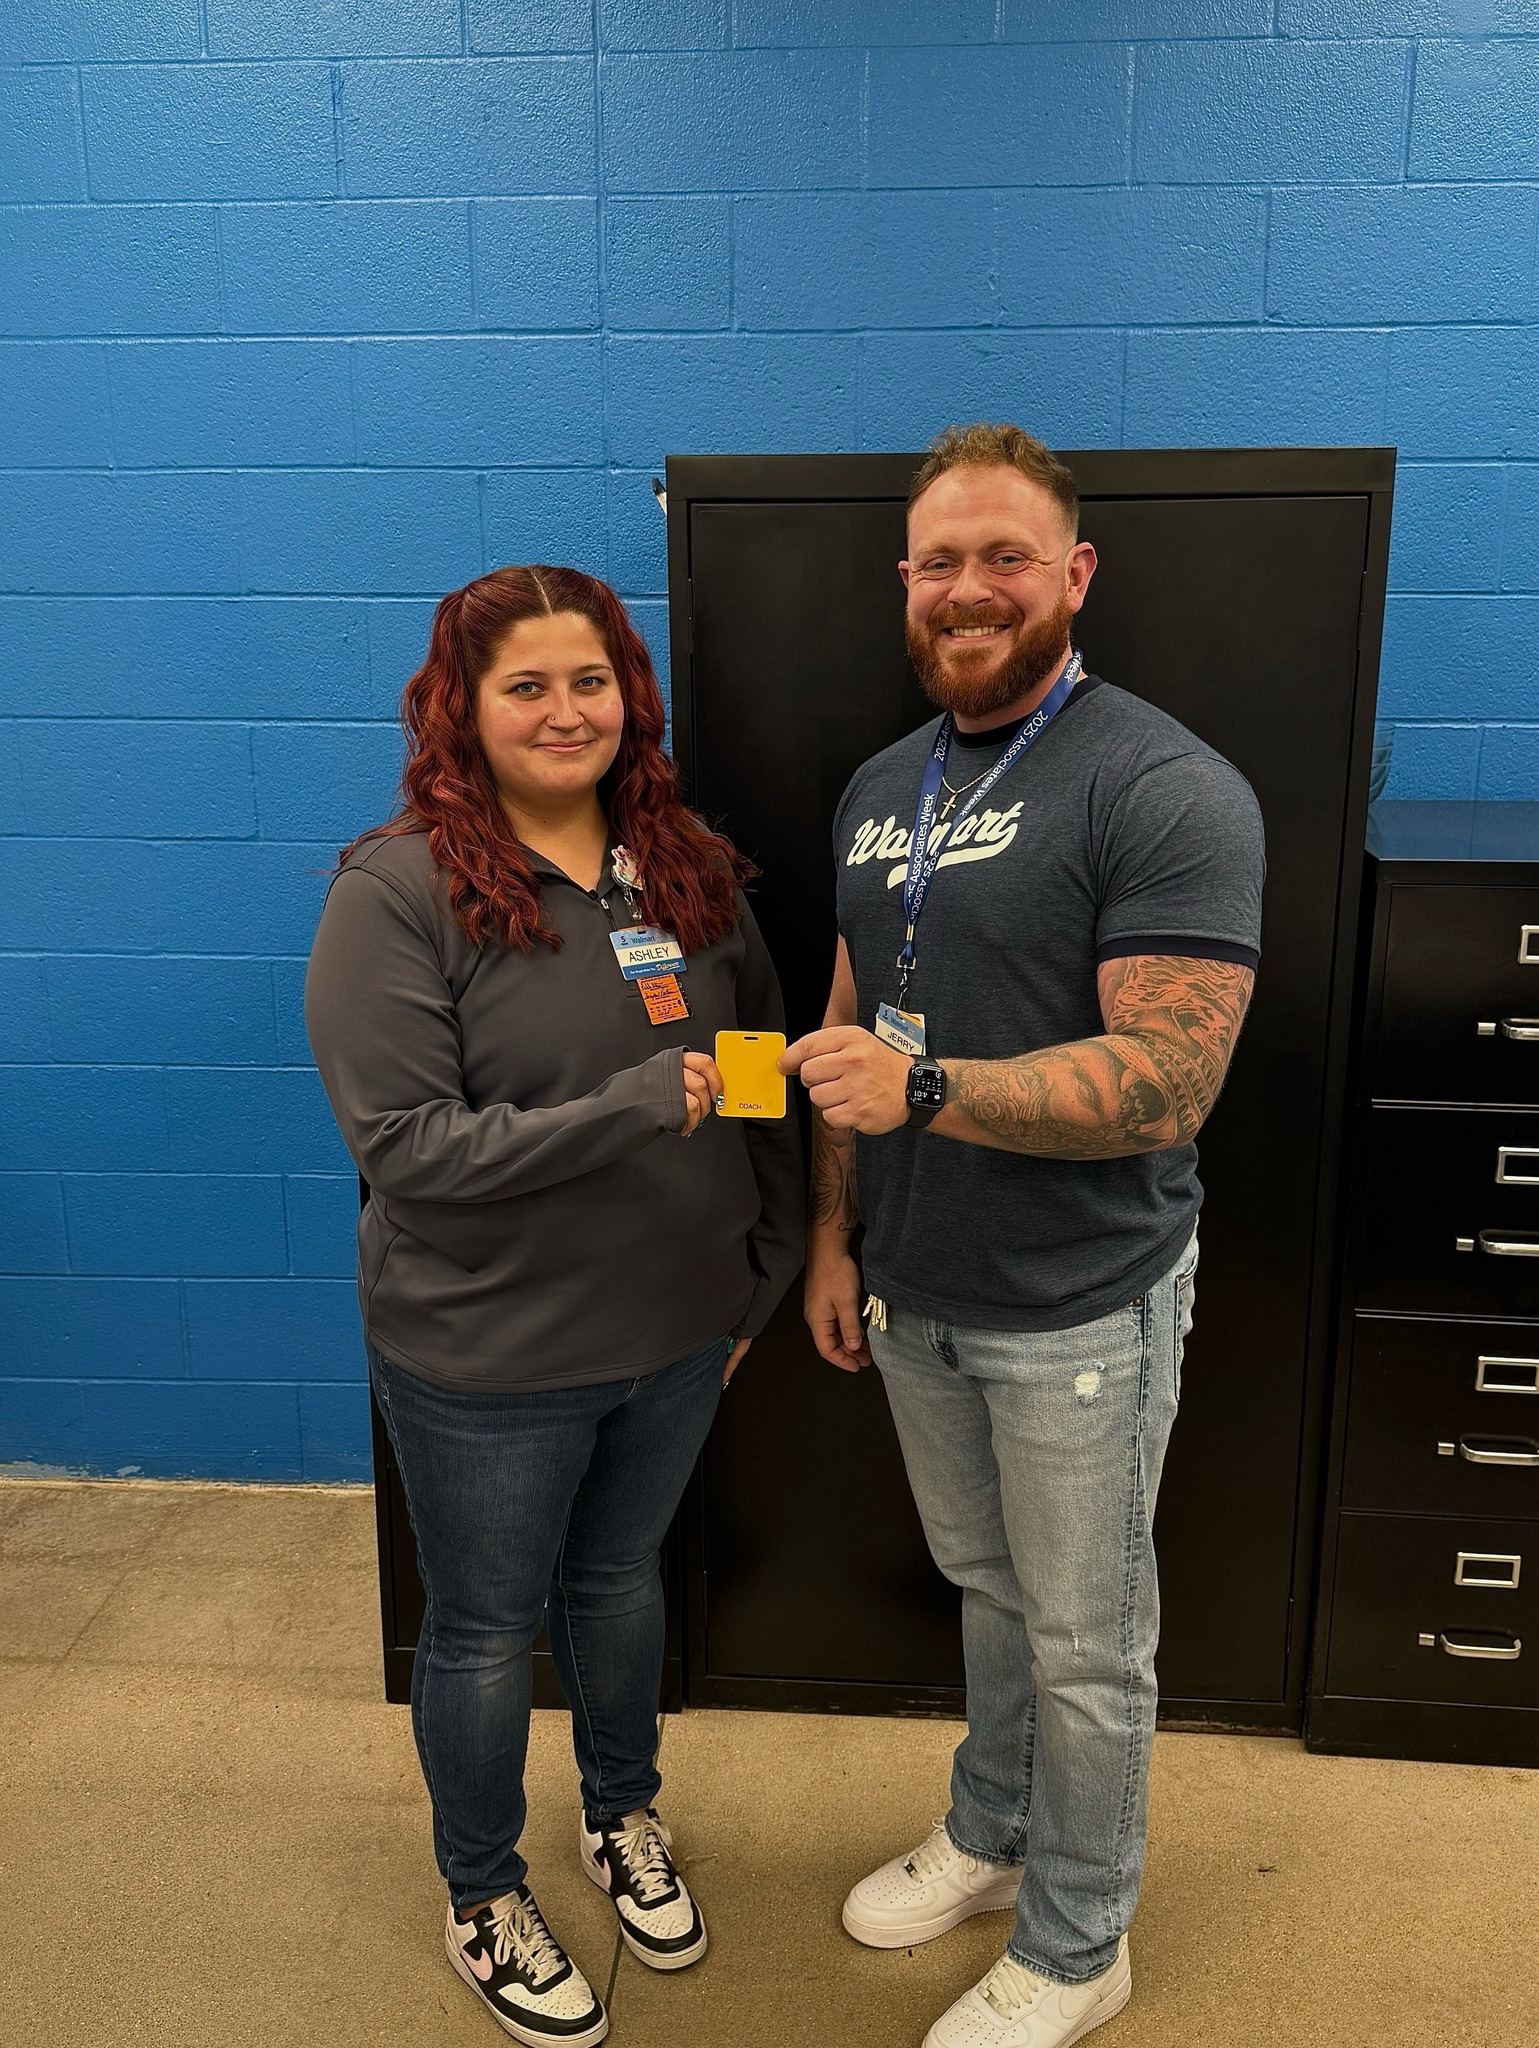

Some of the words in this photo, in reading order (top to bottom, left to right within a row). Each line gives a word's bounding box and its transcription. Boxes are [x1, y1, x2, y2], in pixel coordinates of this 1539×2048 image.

[1023, 710, 1048, 738] 2025
[933, 736, 947, 762] 2025
[981, 735, 1027, 789] Associates
[959, 789, 985, 817] Week
[909, 824, 928, 883] Associates
[919, 793, 935, 825] Week
[630, 935, 656, 945] Walmart
[629, 946, 669, 963] ASHLEY
[887, 1031, 915, 1052] JERRY
